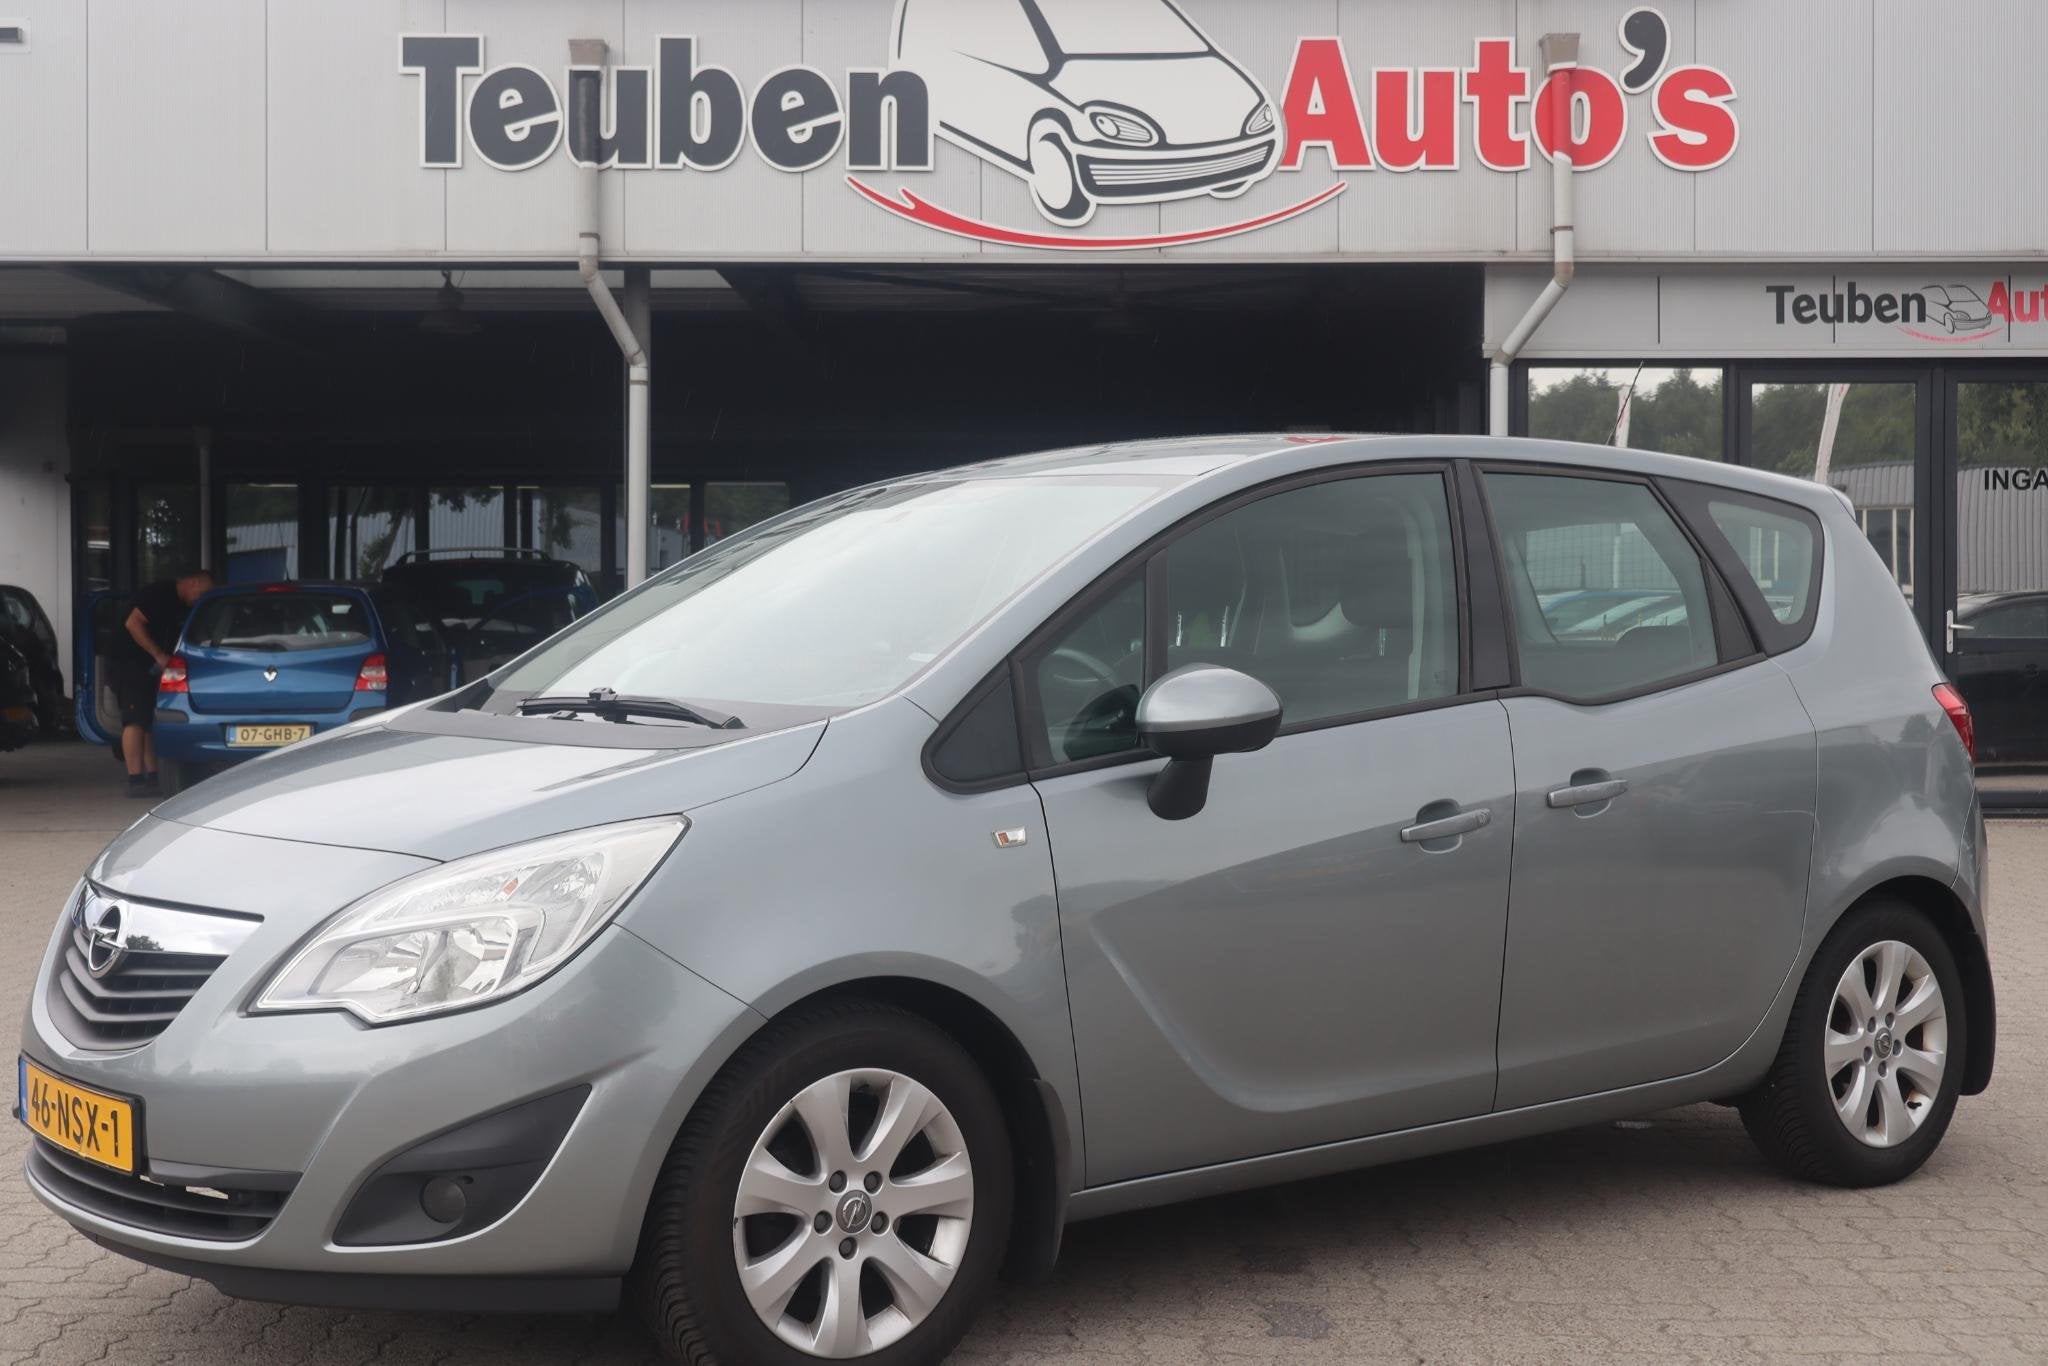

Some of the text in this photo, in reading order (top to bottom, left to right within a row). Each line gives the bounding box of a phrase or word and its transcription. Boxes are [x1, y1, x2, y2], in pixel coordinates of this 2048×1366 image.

[399, 7, 1739, 172] Teuben Auto's
[1766, 281, 1926, 325] Teuben
[1984, 469, 2048, 491] INGA
[240, 727, 306, 742] 07-GHB-7
[31, 1077, 119, 1158] 46-NSX-1
